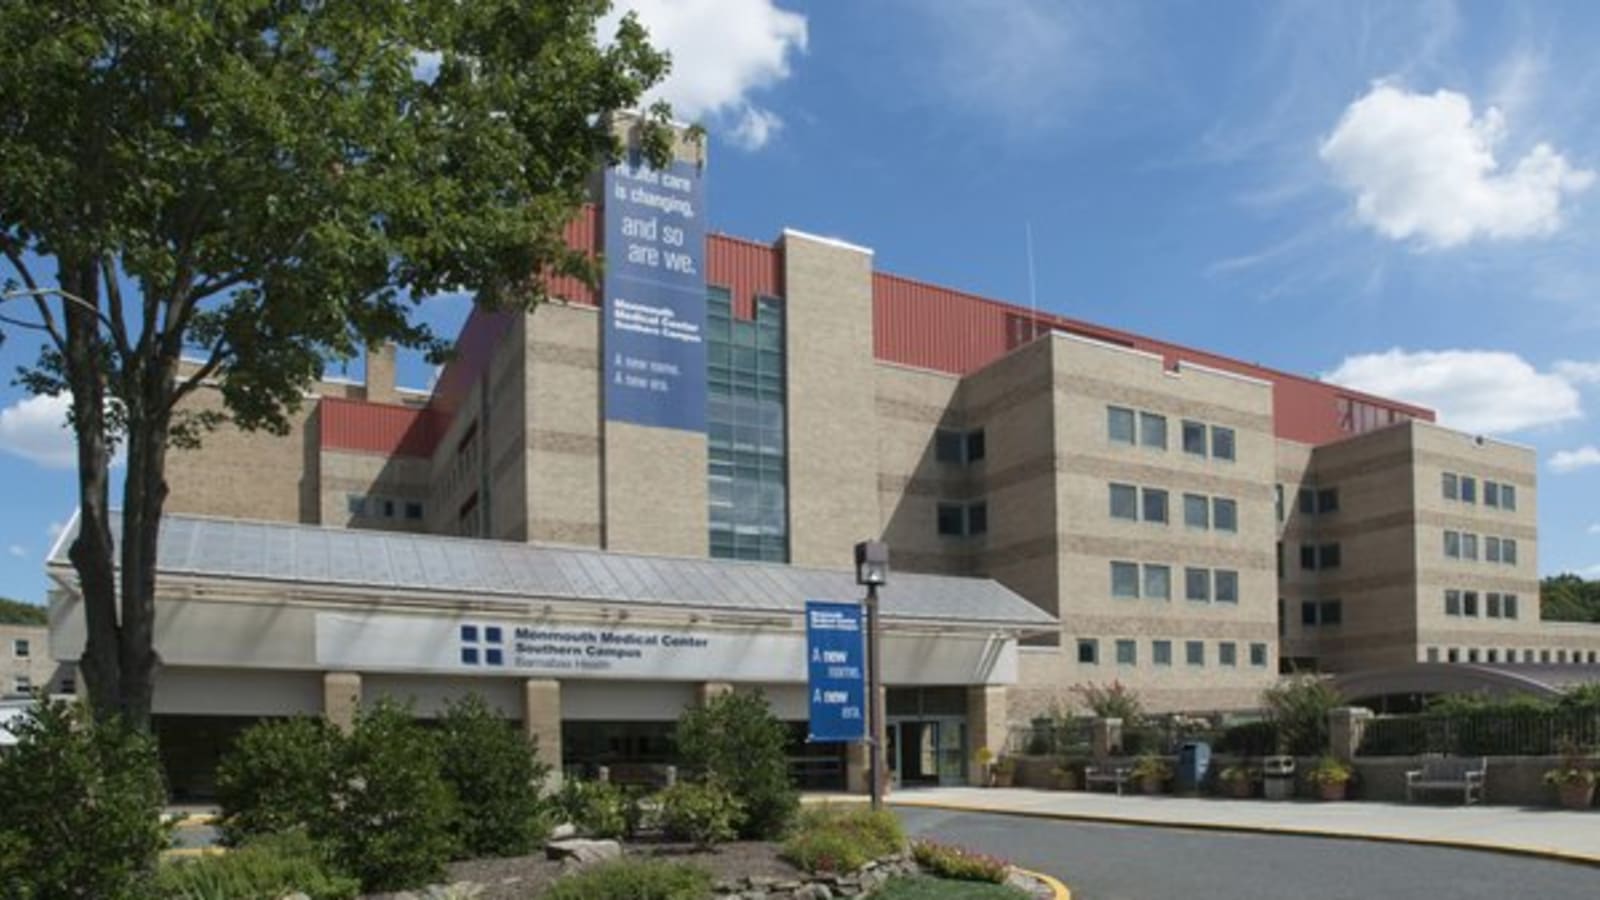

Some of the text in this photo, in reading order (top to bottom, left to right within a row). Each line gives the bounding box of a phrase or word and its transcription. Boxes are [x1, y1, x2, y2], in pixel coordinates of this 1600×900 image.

[661, 173, 691, 192] care
[615, 182, 694, 217] is changing,
[622, 216, 683, 246] and so
[628, 244, 696, 274] are we.
[515, 627, 709, 648] Monmouth Medical Center
[515, 642, 643, 660] Southern Campus
[812, 648, 848, 663] A new
[813, 688, 849, 704] A new
